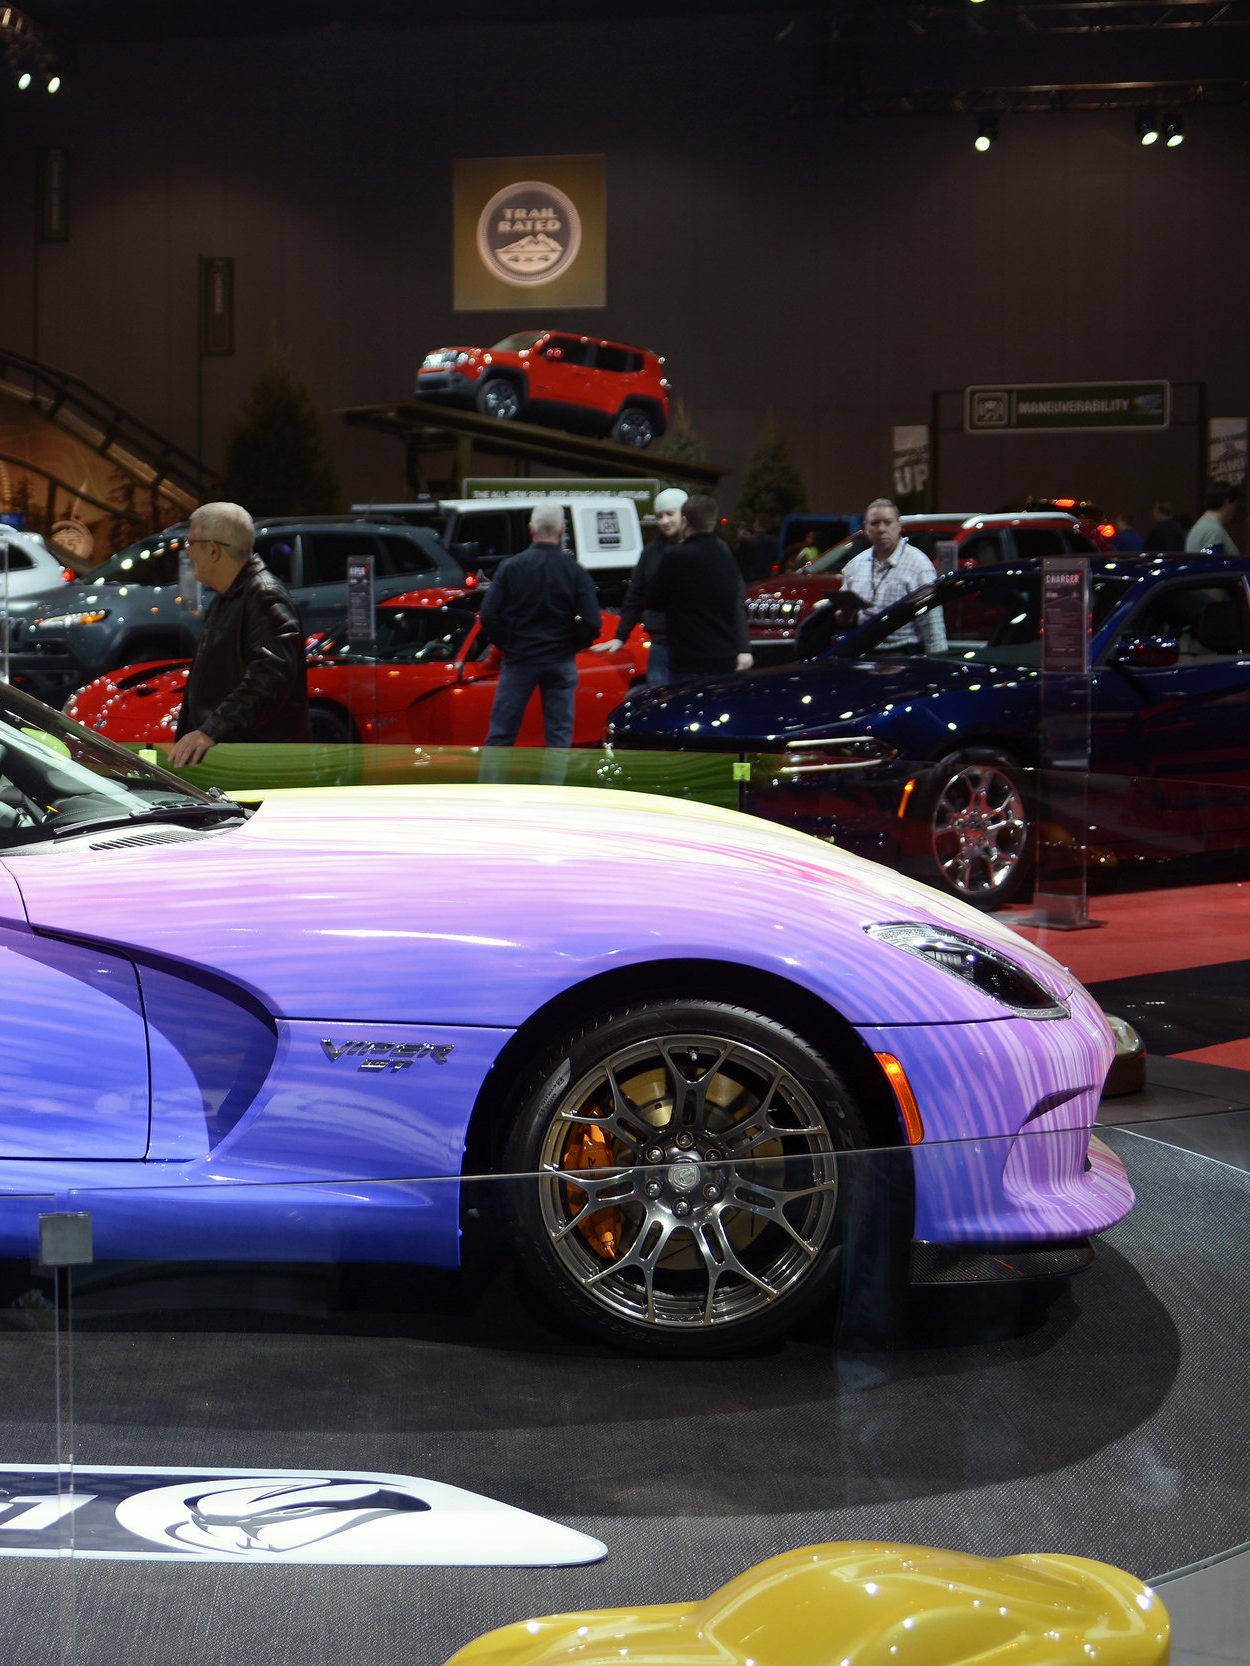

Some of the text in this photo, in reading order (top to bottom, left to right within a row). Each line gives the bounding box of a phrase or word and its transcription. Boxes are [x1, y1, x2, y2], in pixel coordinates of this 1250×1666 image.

[502, 208, 558, 220] TRAIL
[497, 219, 561, 233] RATED
[1018, 397, 1130, 415] MANEUVERABILITY
[1046, 575, 1079, 583] CHARGER
[320, 1039, 454, 1065] VIPER
